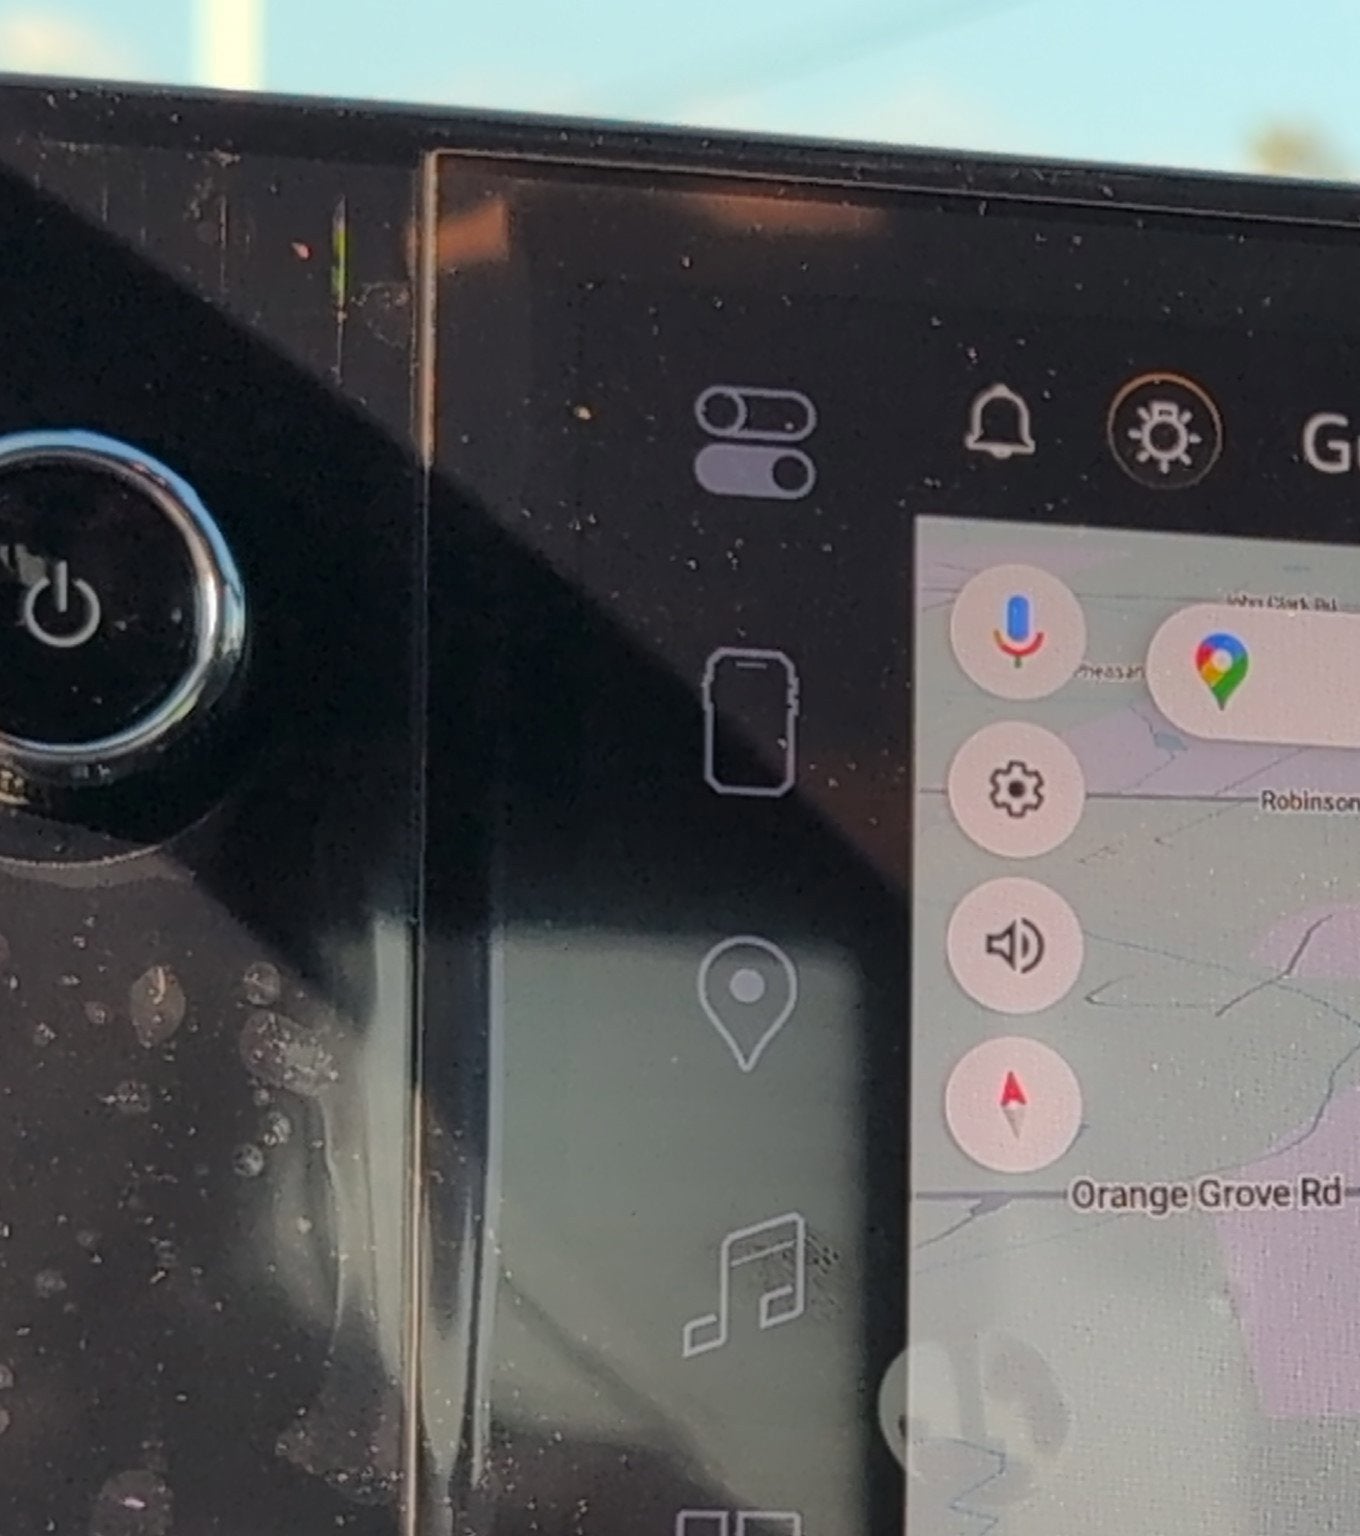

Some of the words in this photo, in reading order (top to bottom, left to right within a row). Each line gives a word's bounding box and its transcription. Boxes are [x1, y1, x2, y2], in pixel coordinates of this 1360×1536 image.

[1072, 1179, 1190, 1216] Orange
[1199, 1178, 1291, 1208] Grove
[1300, 1176, 1342, 1207] Rd
